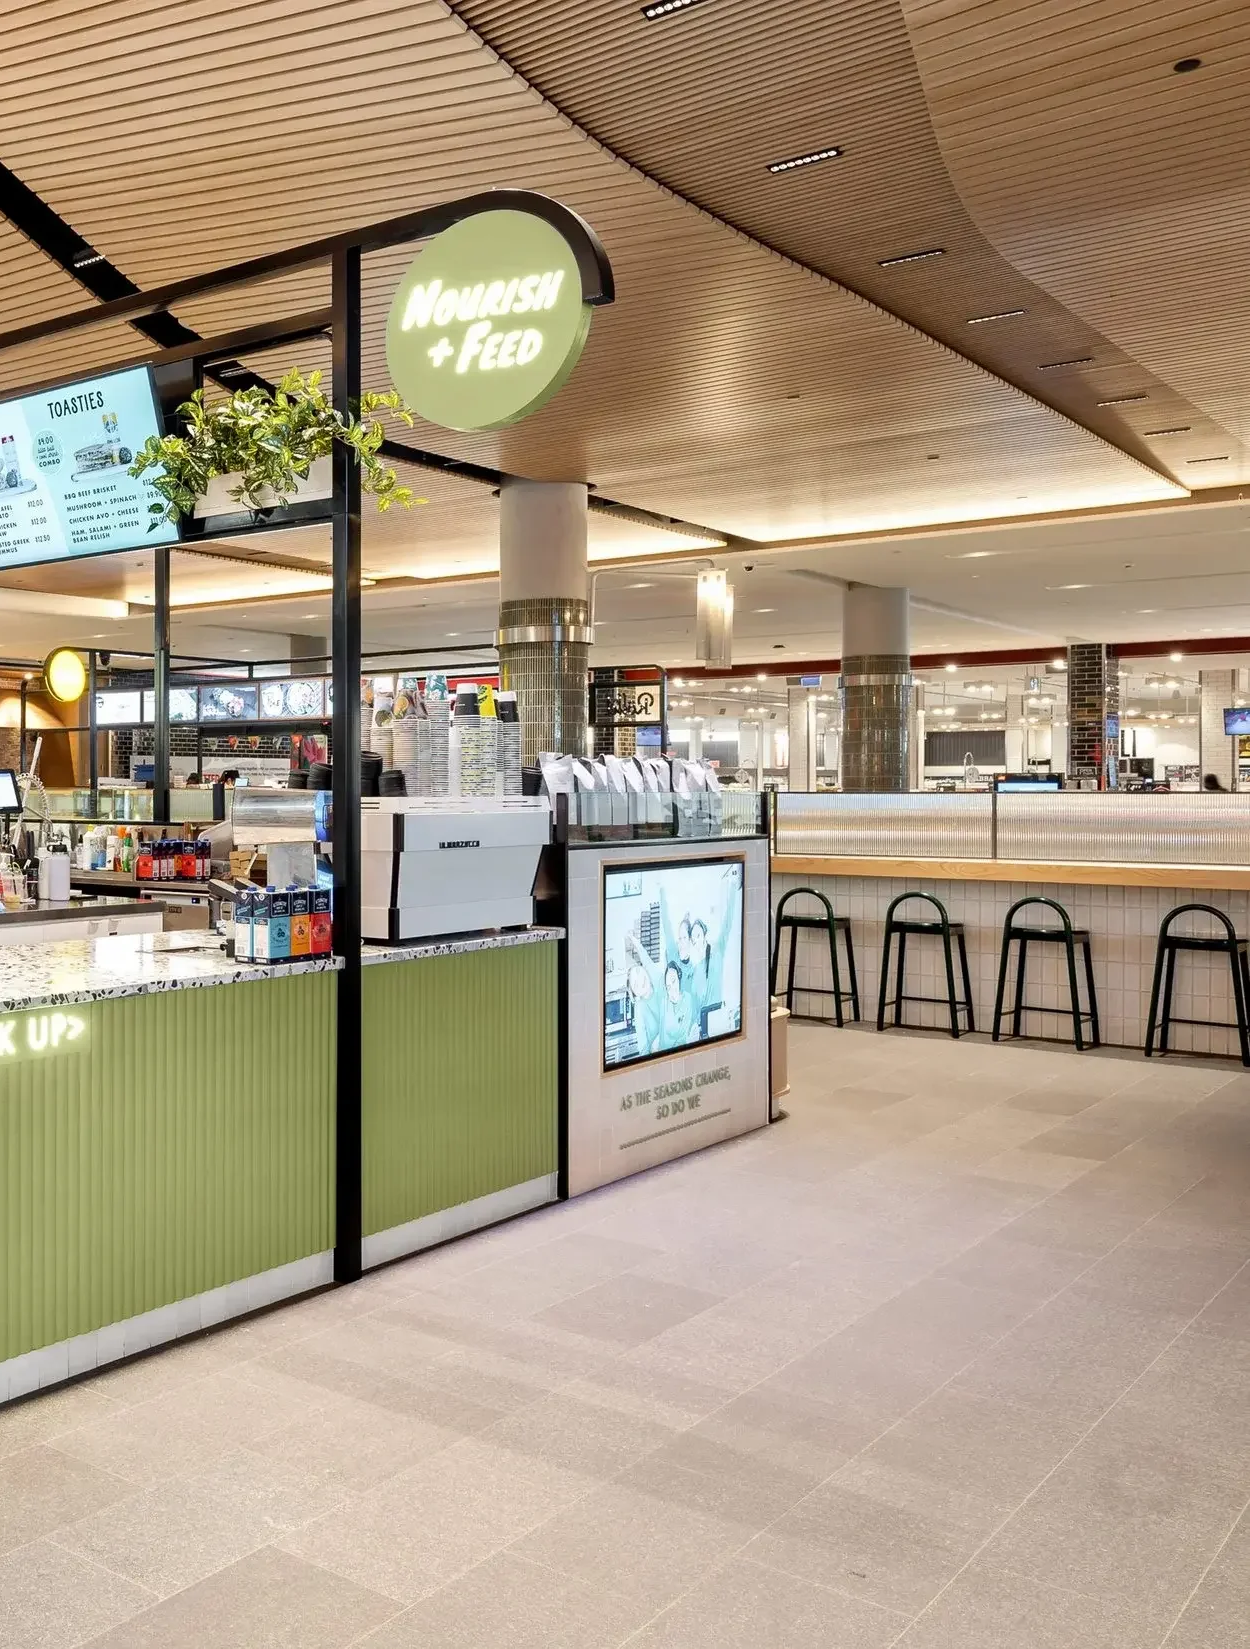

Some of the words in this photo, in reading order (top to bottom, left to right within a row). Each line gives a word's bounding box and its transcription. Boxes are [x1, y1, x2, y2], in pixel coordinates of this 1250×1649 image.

[402, 269, 565, 332] NOURISH
[455, 320, 543, 374] FEED
[47, 391, 104, 419] TOASTIES
[39, 459, 60, 467] COMBO
[93, 485, 117, 495] BRISKET
[67, 501, 102, 512] MUSHROOM
[110, 495, 137, 505] SPINACH
[69, 515, 94, 524] CHICKEN
[117, 507, 139, 517] CHEESE
[119, 521, 139, 529] GREEN
[620, 1094, 632, 1111] AS
[634, 1090, 651, 1106] THE
[653, 1077, 693, 1100] SEASONS
[695, 1066, 731, 1087] CHANGE,
[656, 1104, 669, 1120] SO
[671, 1099, 685, 1115] DO
[687, 1094, 701, 1110] WE
